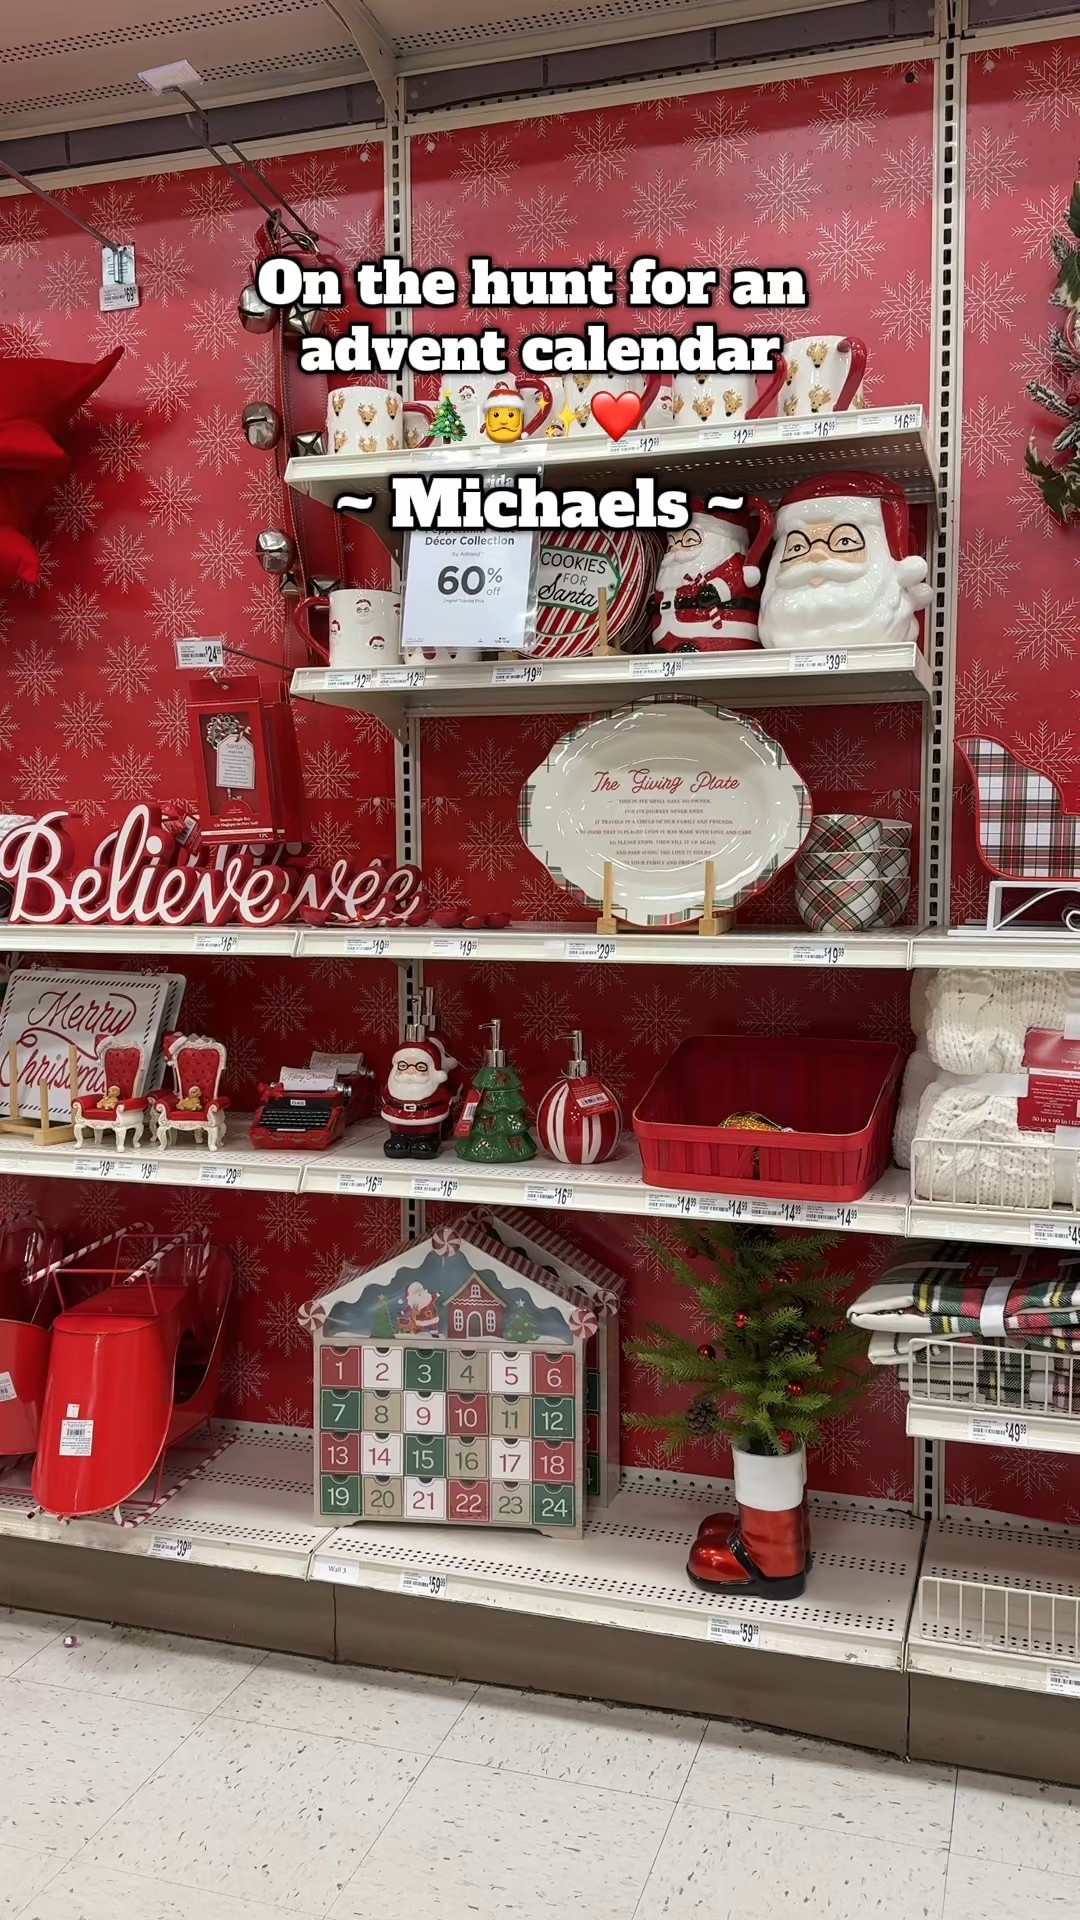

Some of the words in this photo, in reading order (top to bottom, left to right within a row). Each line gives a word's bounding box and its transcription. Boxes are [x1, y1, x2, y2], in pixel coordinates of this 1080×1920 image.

[425, 535, 457, 546] Décor
[459, 535, 515, 546] Collection
[541, 551, 608, 574] COOKIES
[486, 587, 501, 596] off
[537, 573, 598, 608] Santa
[562, 573, 588, 587] FOR
[591, 771, 621, 793] The
[627, 768, 684, 795] Giving
[689, 770, 741, 794] Plate
[0, 804, 283, 925] Believe
[27, 990, 137, 1037] Merry
[335, 1361, 344, 1380] 1
[375, 1363, 390, 1382] 2
[417, 1364, 432, 1383] 3
[459, 1365, 475, 1384] 4
[504, 1366, 519, 1386] 5
[546, 1368, 562, 1388] 6
[332, 1404, 346, 1422] 7
[374, 1405, 389, 1424] 8
[416, 1407, 431, 1426] 9
[455, 1408, 478, 1428] 10
[501, 1410, 519, 1429] 11
[541, 1412, 564, 1431] 12
[328, 1446, 349, 1465] 13
[368, 1447, 392, 1467] 14
[412, 1450, 435, 1469] 15
[455, 1451, 479, 1471] 16
[499, 1454, 522, 1473] 17
[540, 1455, 565, 1475] 18
[327, 1487, 350, 1506] 19
[370, 1489, 395, 1508] 20
[412, 1491, 435, 1511] 21
[455, 1494, 482, 1513] 22
[498, 1495, 523, 1515] 23
[541, 1498, 568, 1518] 24
[328, 1564, 341, 1574] Wall
[342, 1567, 347, 1575] 3
